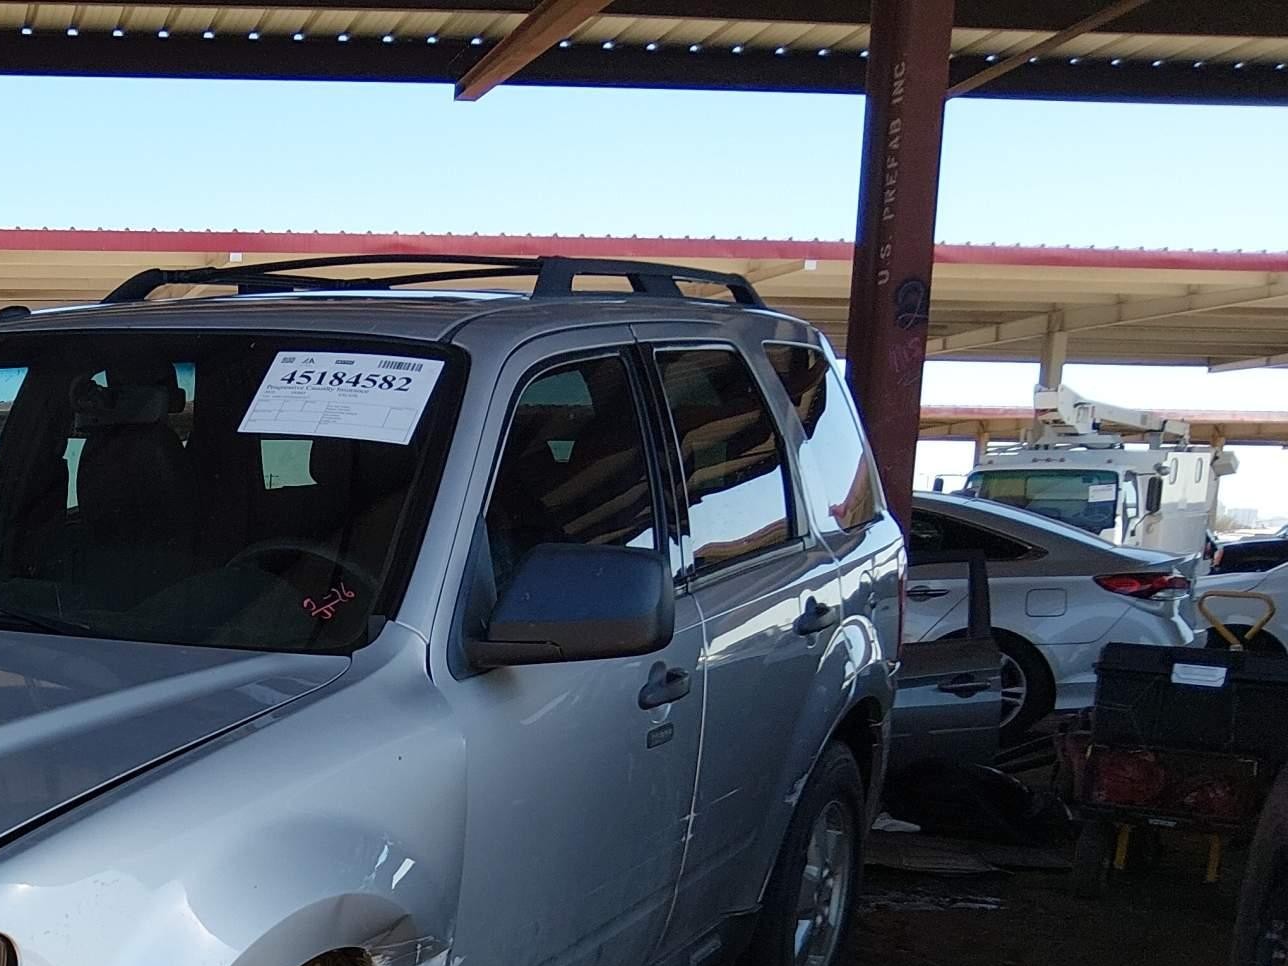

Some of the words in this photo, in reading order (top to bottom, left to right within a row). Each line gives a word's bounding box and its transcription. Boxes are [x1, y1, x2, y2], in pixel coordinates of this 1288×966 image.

[881, 116, 903, 222] PREFAB
[877, 234, 894, 286] U.S.
[280, 369, 413, 393] 45184582
